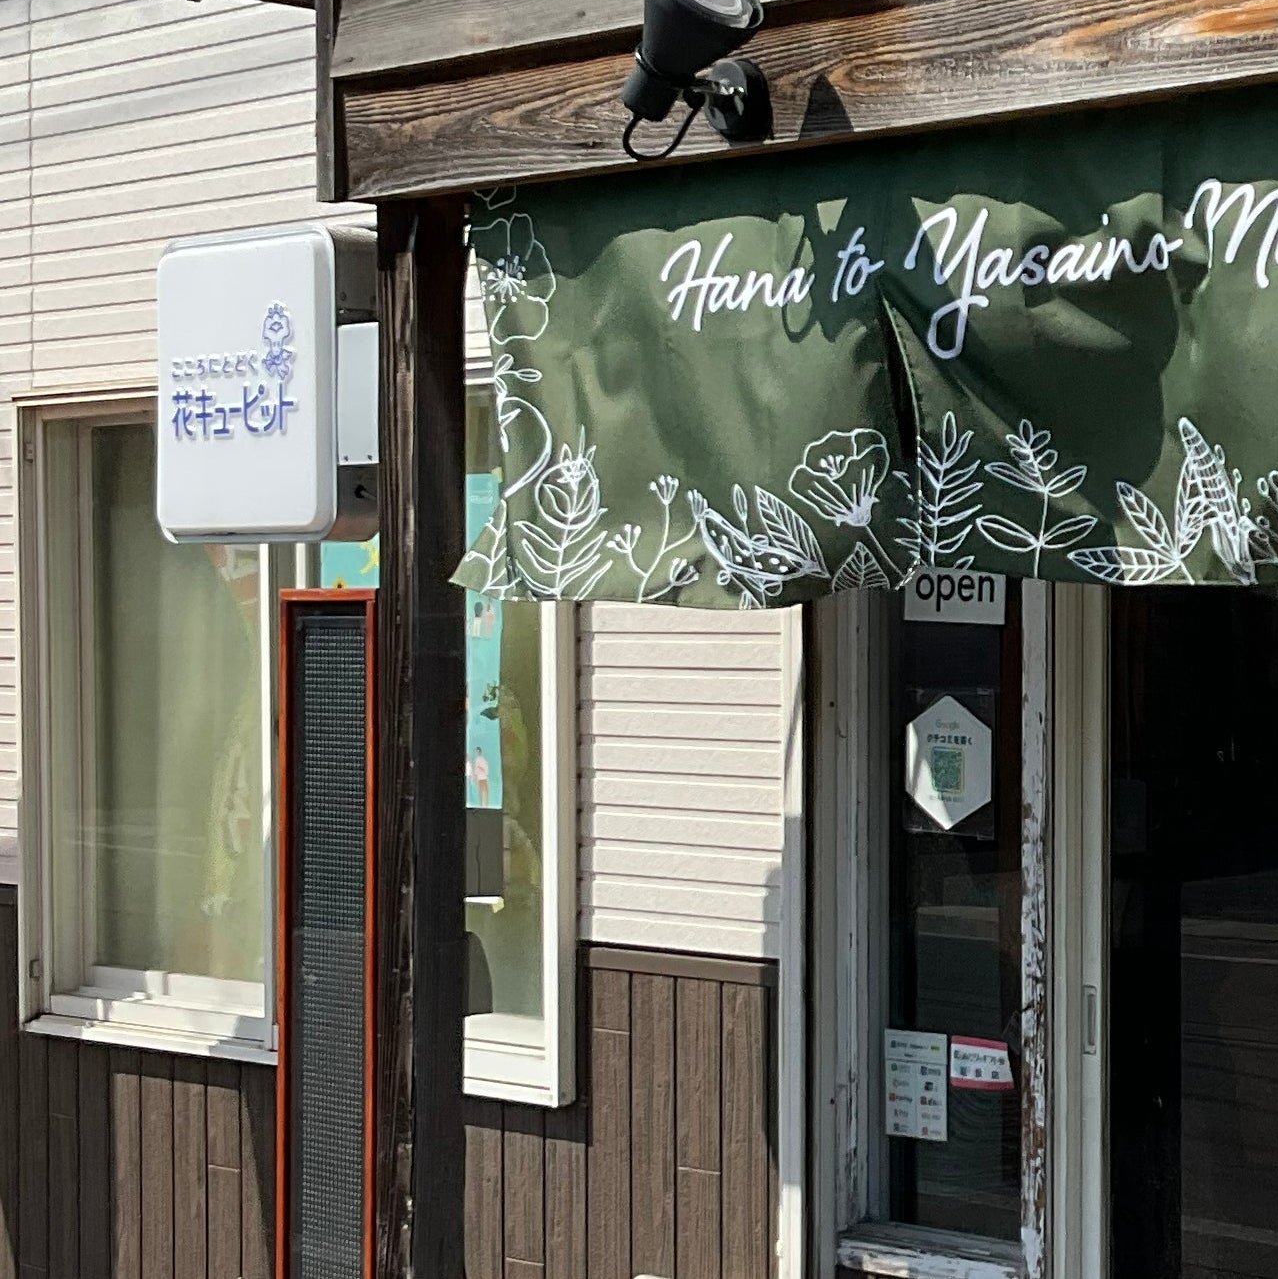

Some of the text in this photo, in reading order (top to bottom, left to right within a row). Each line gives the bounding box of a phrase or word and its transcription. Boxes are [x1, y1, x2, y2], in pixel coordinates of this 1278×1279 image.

[660, 232, 815, 332] Hana
[831, 226, 885, 302] to
[904, 207, 1182, 360] Yasaino
[171, 354, 257, 378] こころにとどく
[171, 382, 294, 437] 花キューピット
[915, 574, 995, 612] open
